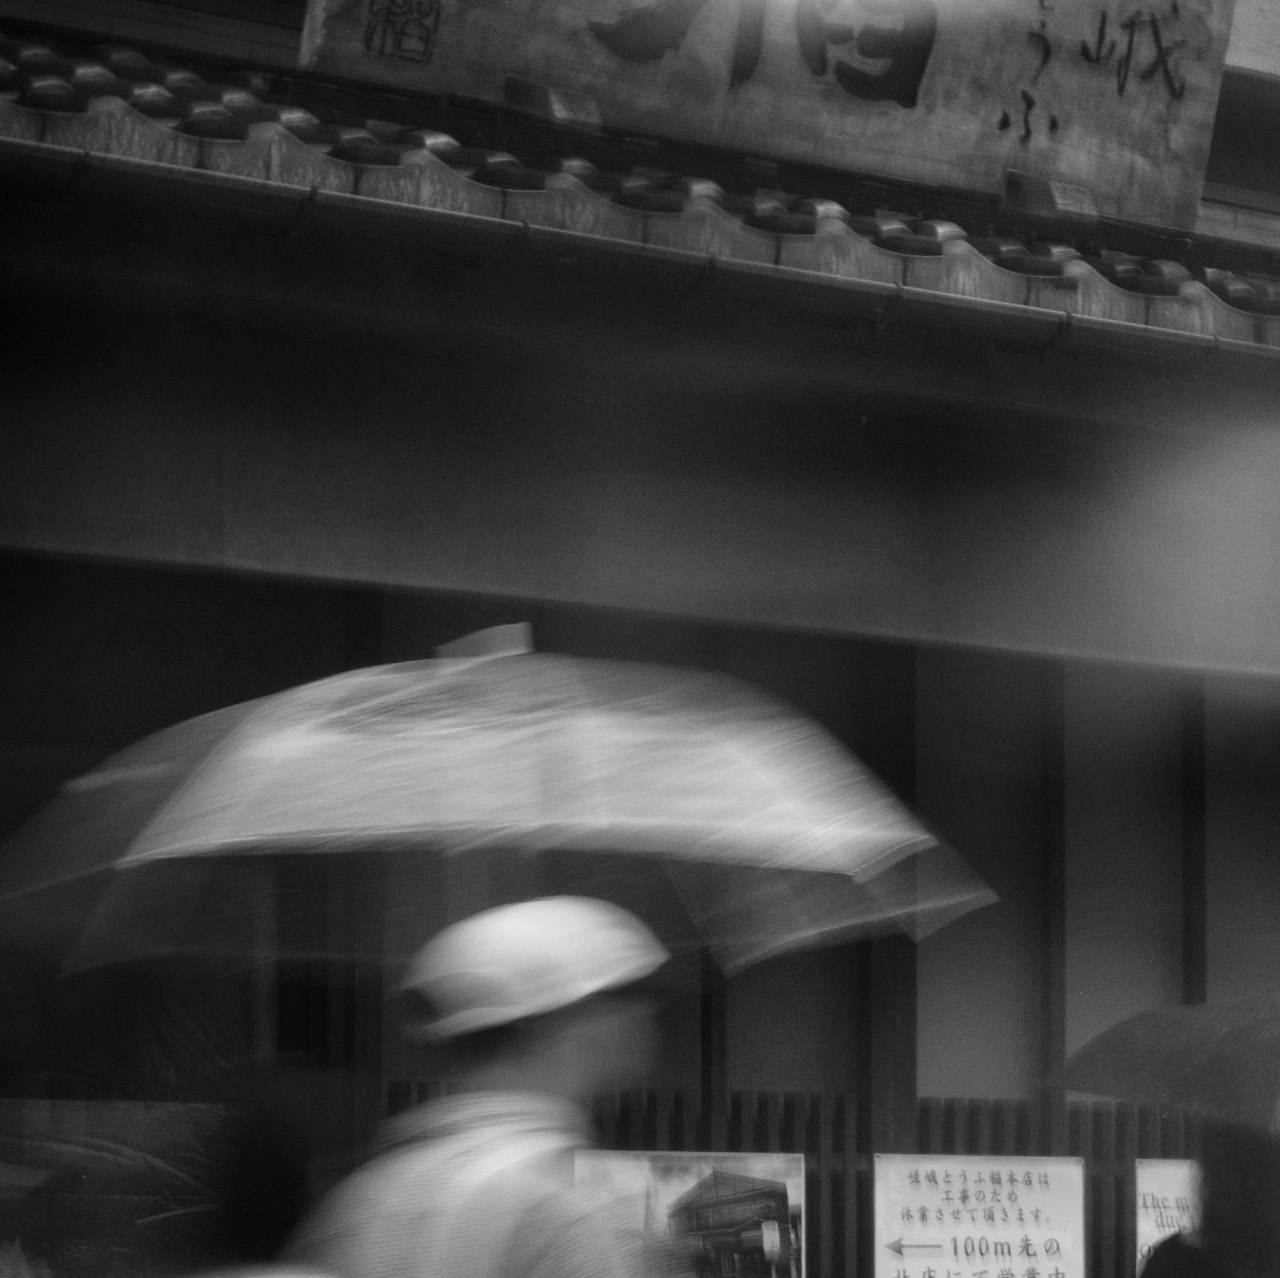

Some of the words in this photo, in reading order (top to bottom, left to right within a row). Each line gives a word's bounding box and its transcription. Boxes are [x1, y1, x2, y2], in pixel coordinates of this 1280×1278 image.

[941, 1189, 1019, 1204] 工事のため
[901, 1205, 1050, 1223] 休業させて頂きます。
[949, 1234, 1061, 1257] 100m先の
